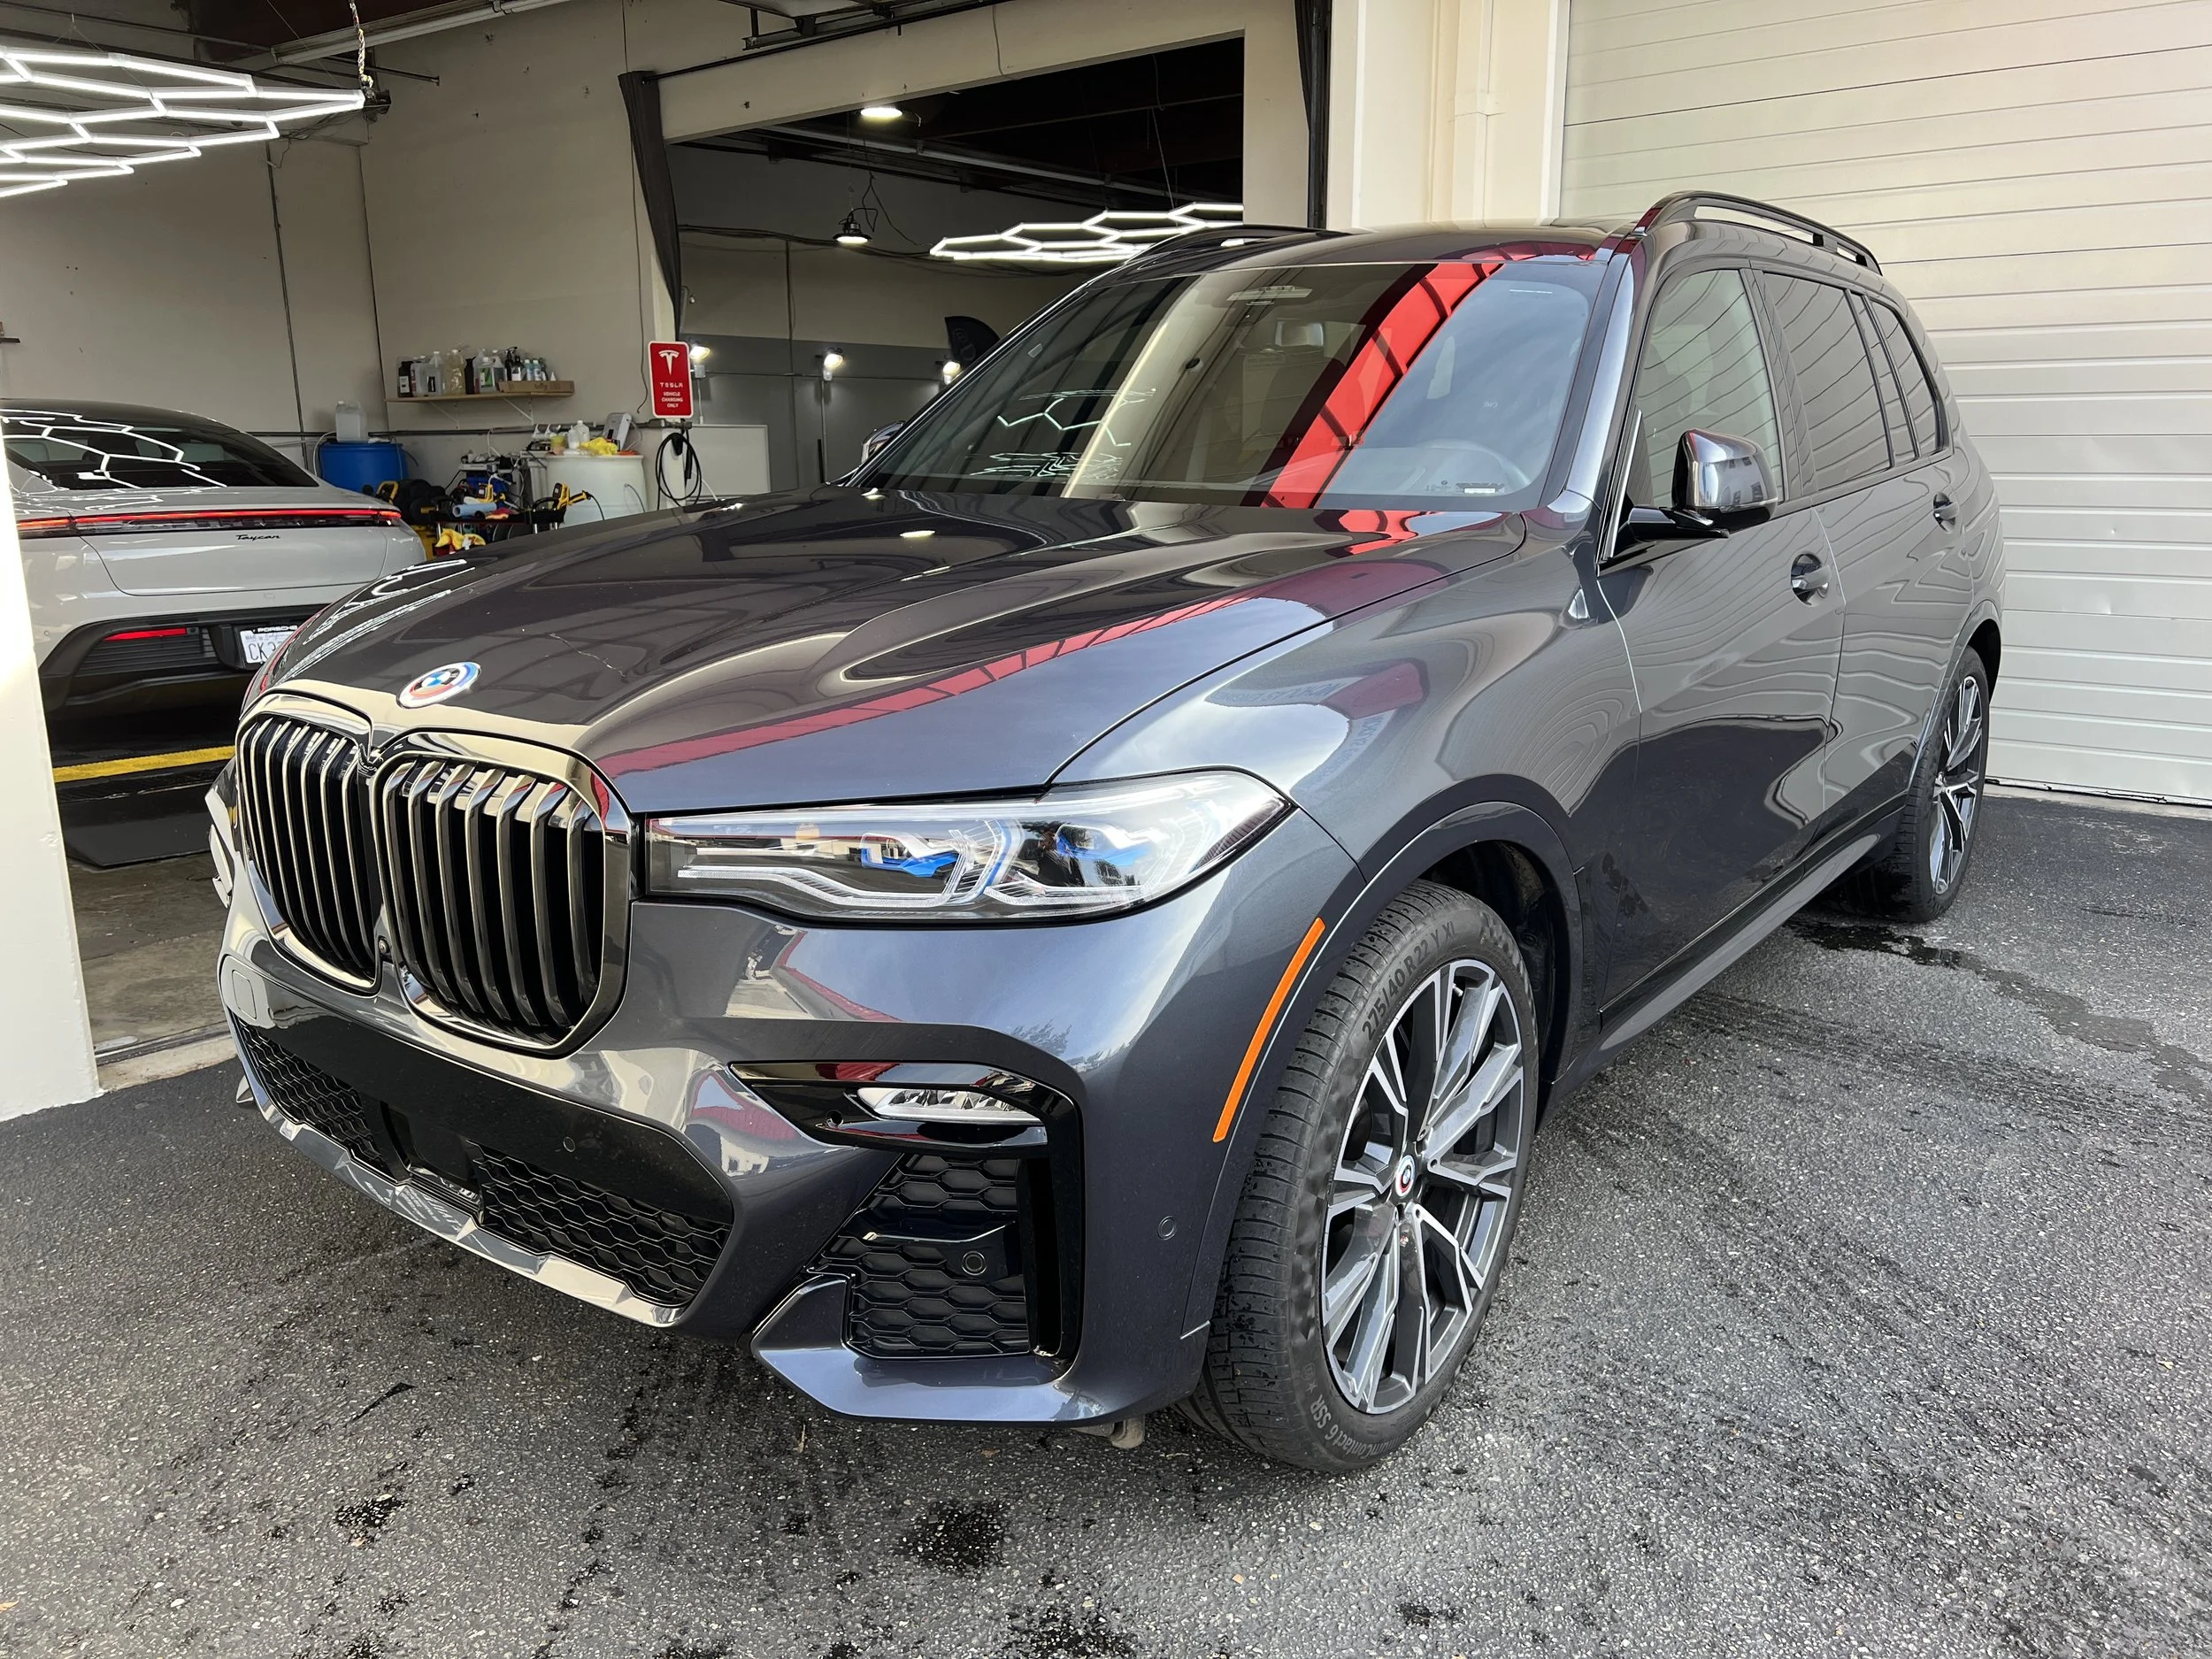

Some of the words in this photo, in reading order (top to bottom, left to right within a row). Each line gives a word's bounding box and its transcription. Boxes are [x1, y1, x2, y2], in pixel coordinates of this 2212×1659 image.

[1362, 968, 1406, 1041] 275/40
[1310, 1394, 1332, 1429] SSR
[1325, 1424, 1339, 1440] 6
